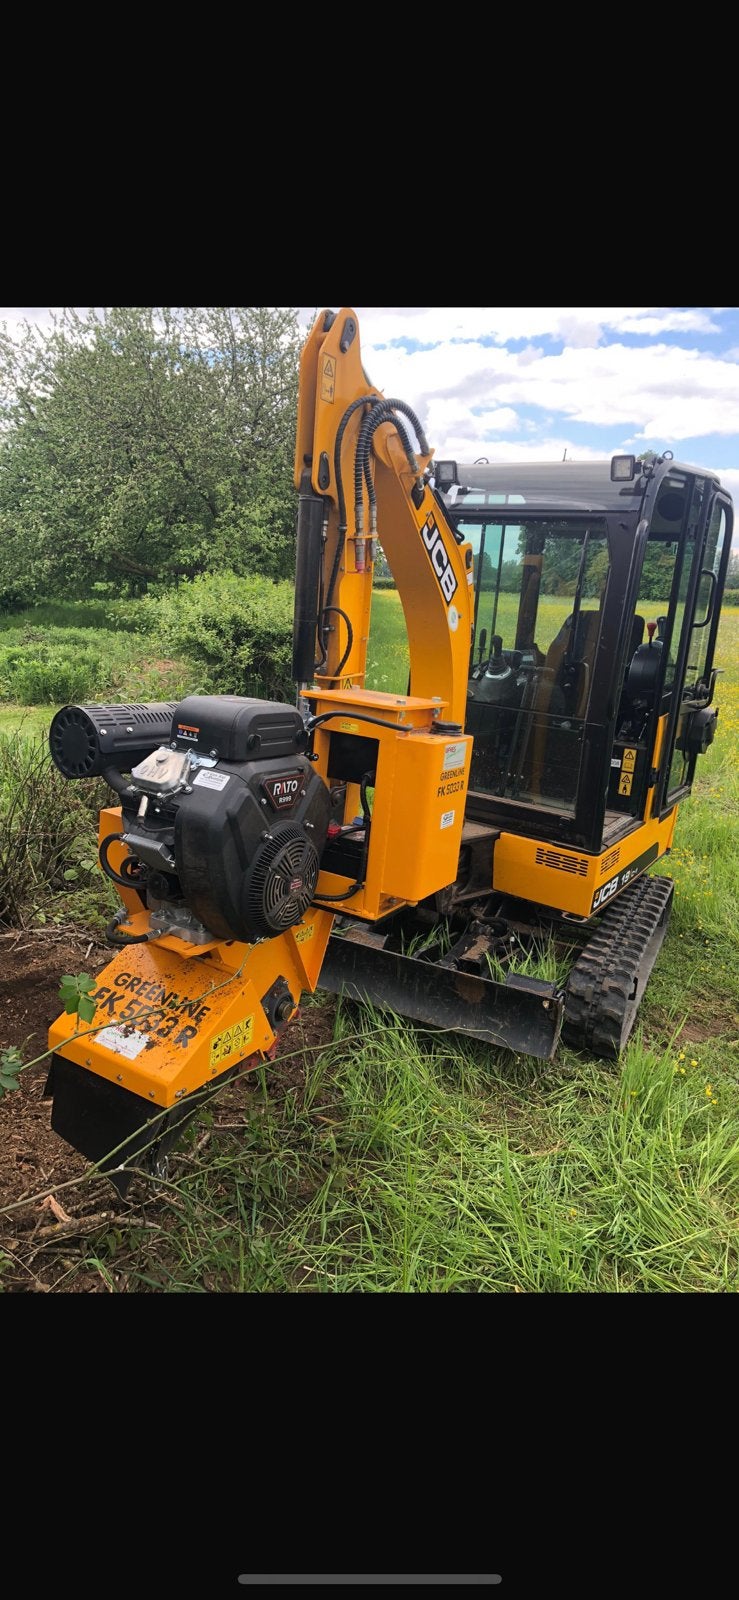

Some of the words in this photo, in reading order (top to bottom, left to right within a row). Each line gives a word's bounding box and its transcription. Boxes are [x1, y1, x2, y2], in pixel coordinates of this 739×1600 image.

[422, 523, 457, 602] JCB
[440, 767, 465, 781] GREENLINE
[273, 780, 298, 796] RATO
[438, 786, 446, 797] FK
[460, 780, 465, 791] R
[279, 795, 292, 803] R999
[593, 876, 619, 909] JCB
[93, 987, 125, 1015] FK
[119, 999, 180, 1038] 5033
[173, 1024, 198, 1049] R
